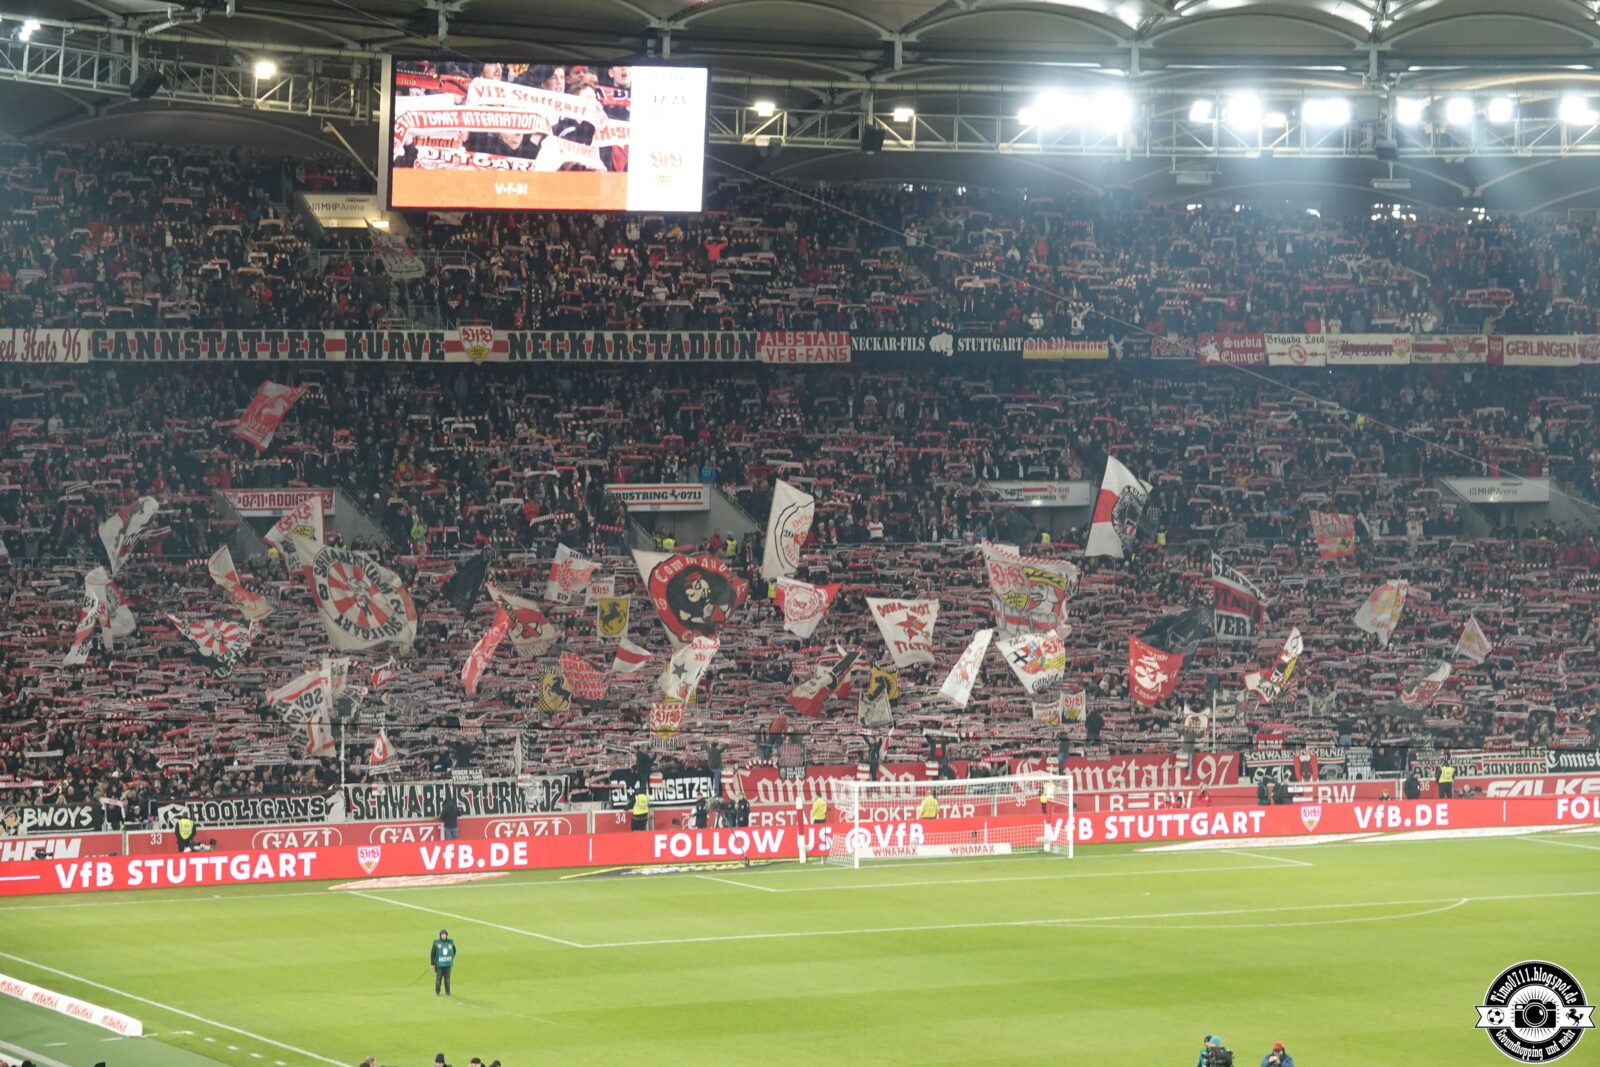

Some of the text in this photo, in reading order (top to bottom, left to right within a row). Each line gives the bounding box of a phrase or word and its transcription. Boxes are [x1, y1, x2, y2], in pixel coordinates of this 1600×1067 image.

[0, 336, 18, 360] ed
[63, 328, 81, 362] 96
[92, 330, 446, 360] CANNSTATTER KURVE
[507, 331, 758, 361] NECKARSTADION
[763, 331, 849, 346] ALBSTADT
[851, 336, 1024, 352] NECKAR-FILS STUTTGART
[1506, 340, 1577, 359] GERLINGEN
[766, 347, 848, 362] VFB-FANS
[1197, 756, 1234, 788] 97
[23, 805, 93, 829] BWOYS
[187, 796, 326, 823] HOOLIGANS
[615, 813, 626, 825] 34
[1354, 803, 1449, 830] VfB.DE
[150, 833, 163, 845] 33
[1105, 811, 1266, 840] STUTTGART
[420, 842, 528, 870] VfB.DE
[654, 829, 785, 859] FOLLOW
[55, 851, 317, 889] VfB STUTTGART
